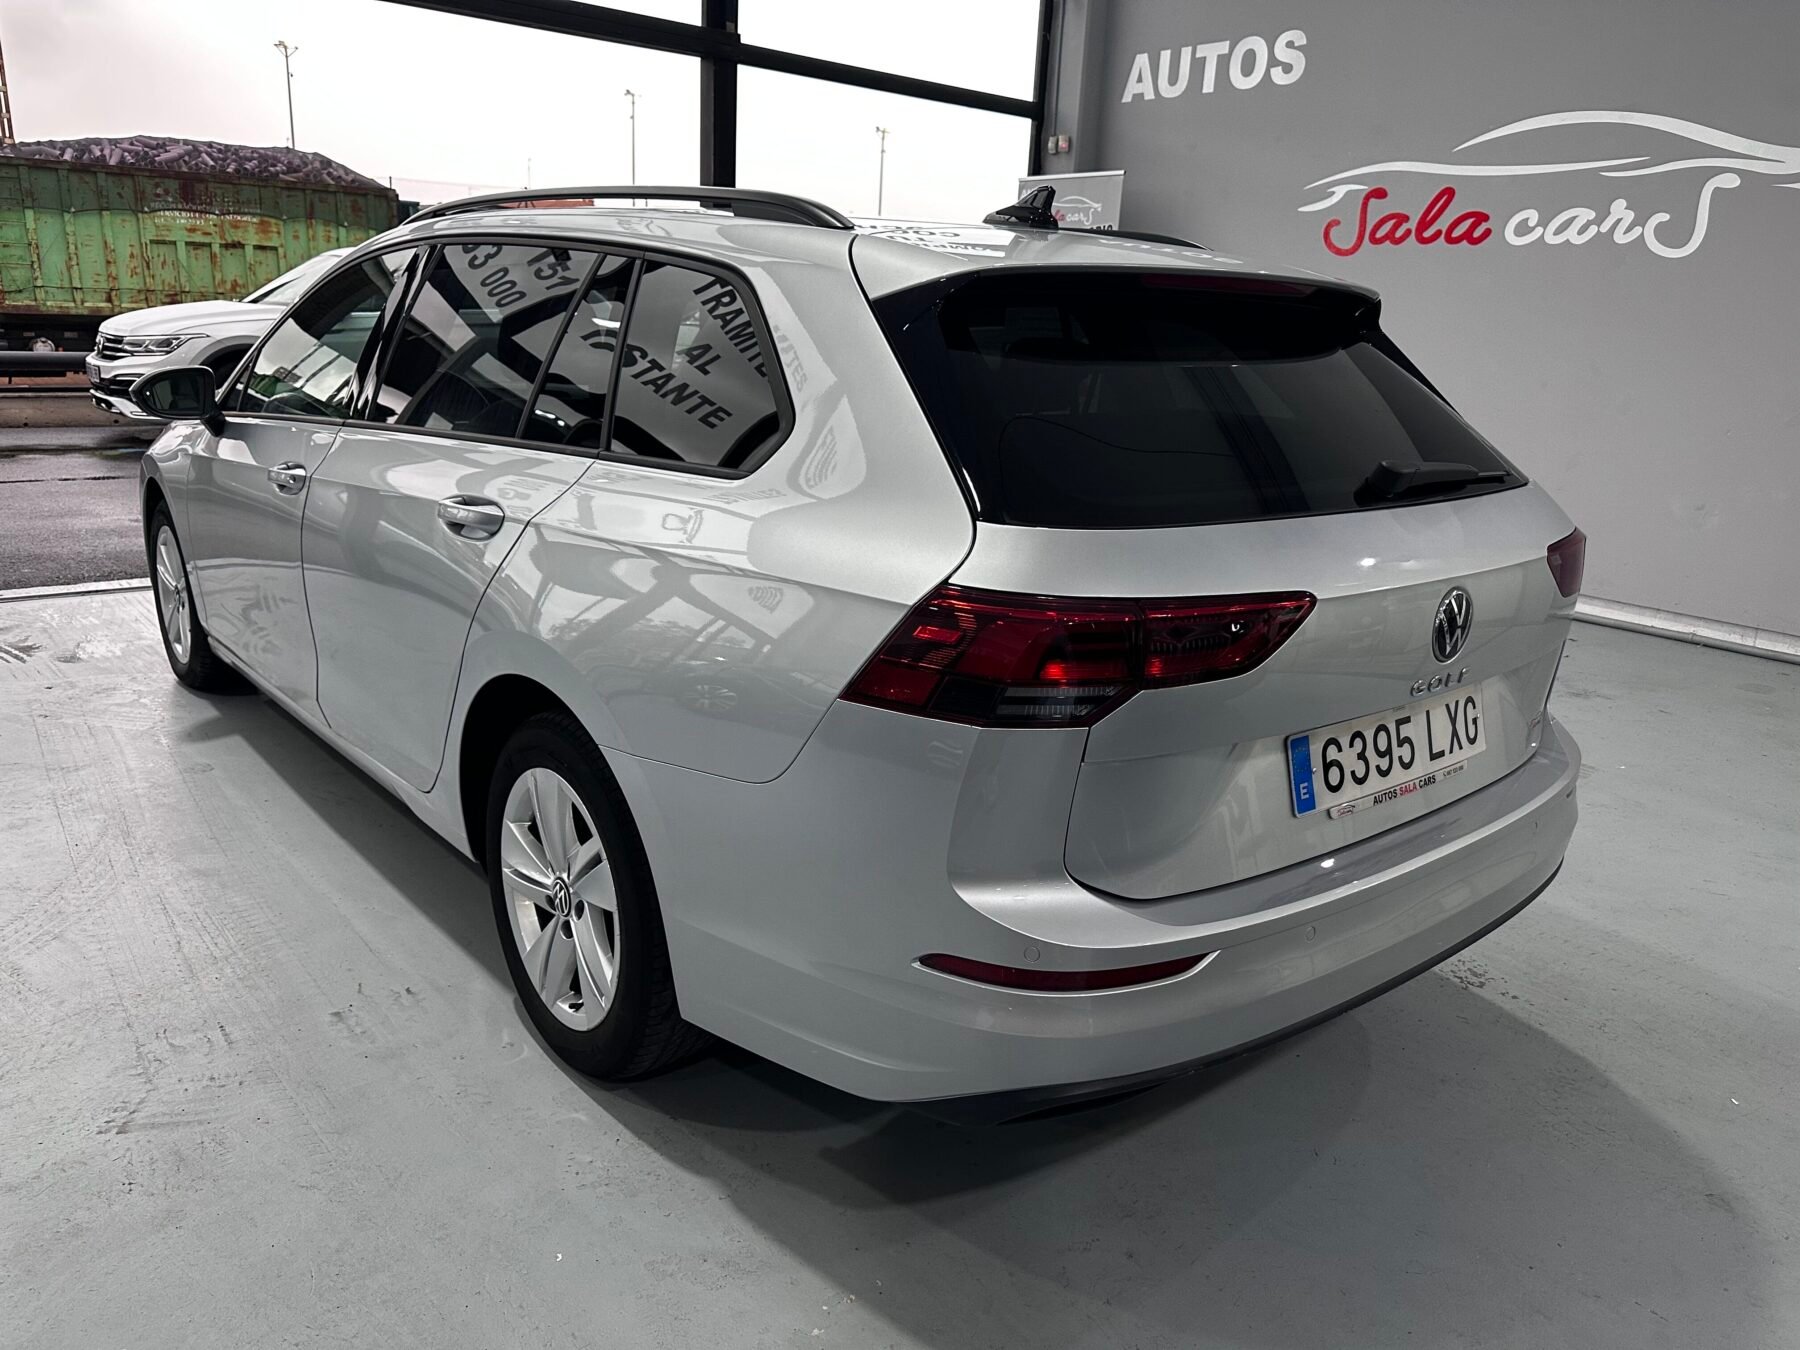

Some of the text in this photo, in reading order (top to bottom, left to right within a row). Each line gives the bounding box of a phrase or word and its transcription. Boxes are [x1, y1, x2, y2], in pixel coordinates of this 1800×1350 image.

[1122, 29, 1307, 104] AUTOS
[1323, 186, 1493, 257] Sala
[675, 343, 721, 376] AL
[1410, 667, 1471, 696] GOLF
[1321, 695, 1479, 794] 6395 LXG
[1299, 782, 1309, 800] E
[1373, 774, 1437, 806] AUTOS SALA CARS
